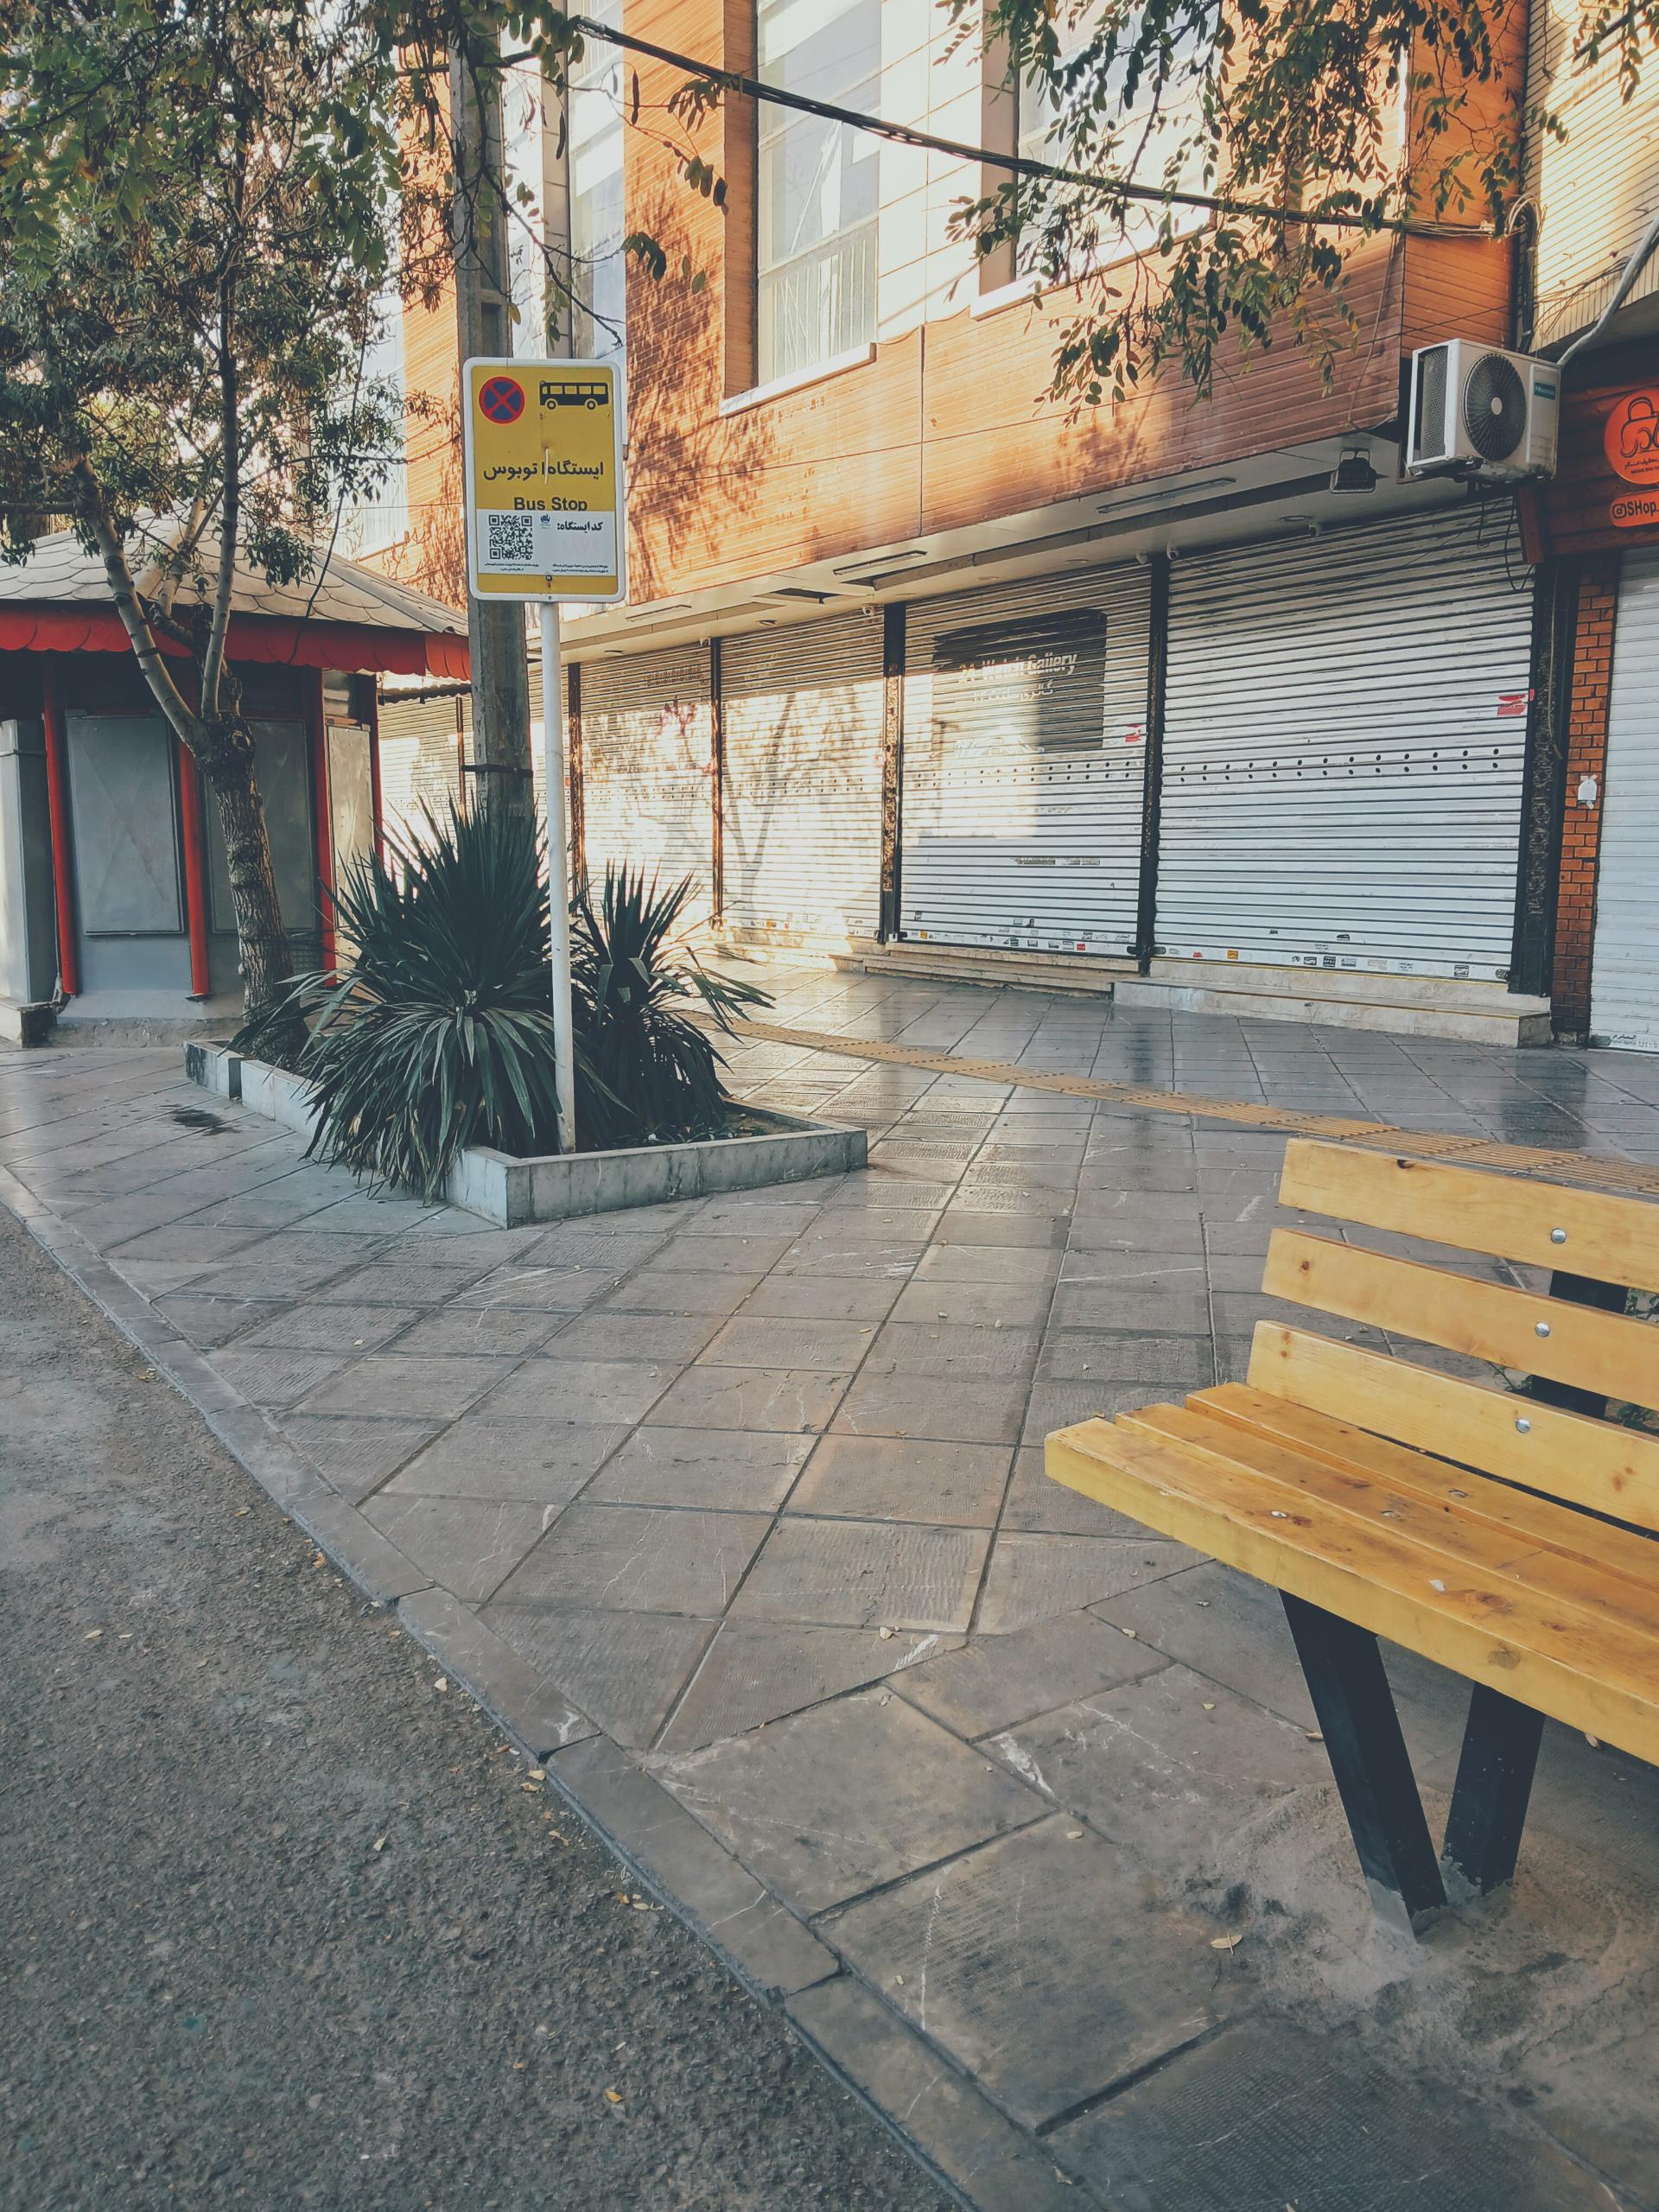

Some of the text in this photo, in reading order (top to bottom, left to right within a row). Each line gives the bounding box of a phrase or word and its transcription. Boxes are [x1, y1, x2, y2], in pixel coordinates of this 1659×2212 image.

[483, 460, 604, 481] ایستگاه اتوبوس
[513, 496, 588, 512] Bus Stop
[591, 521, 604, 531] کد
[1027, 652, 1077, 676] Gallery
